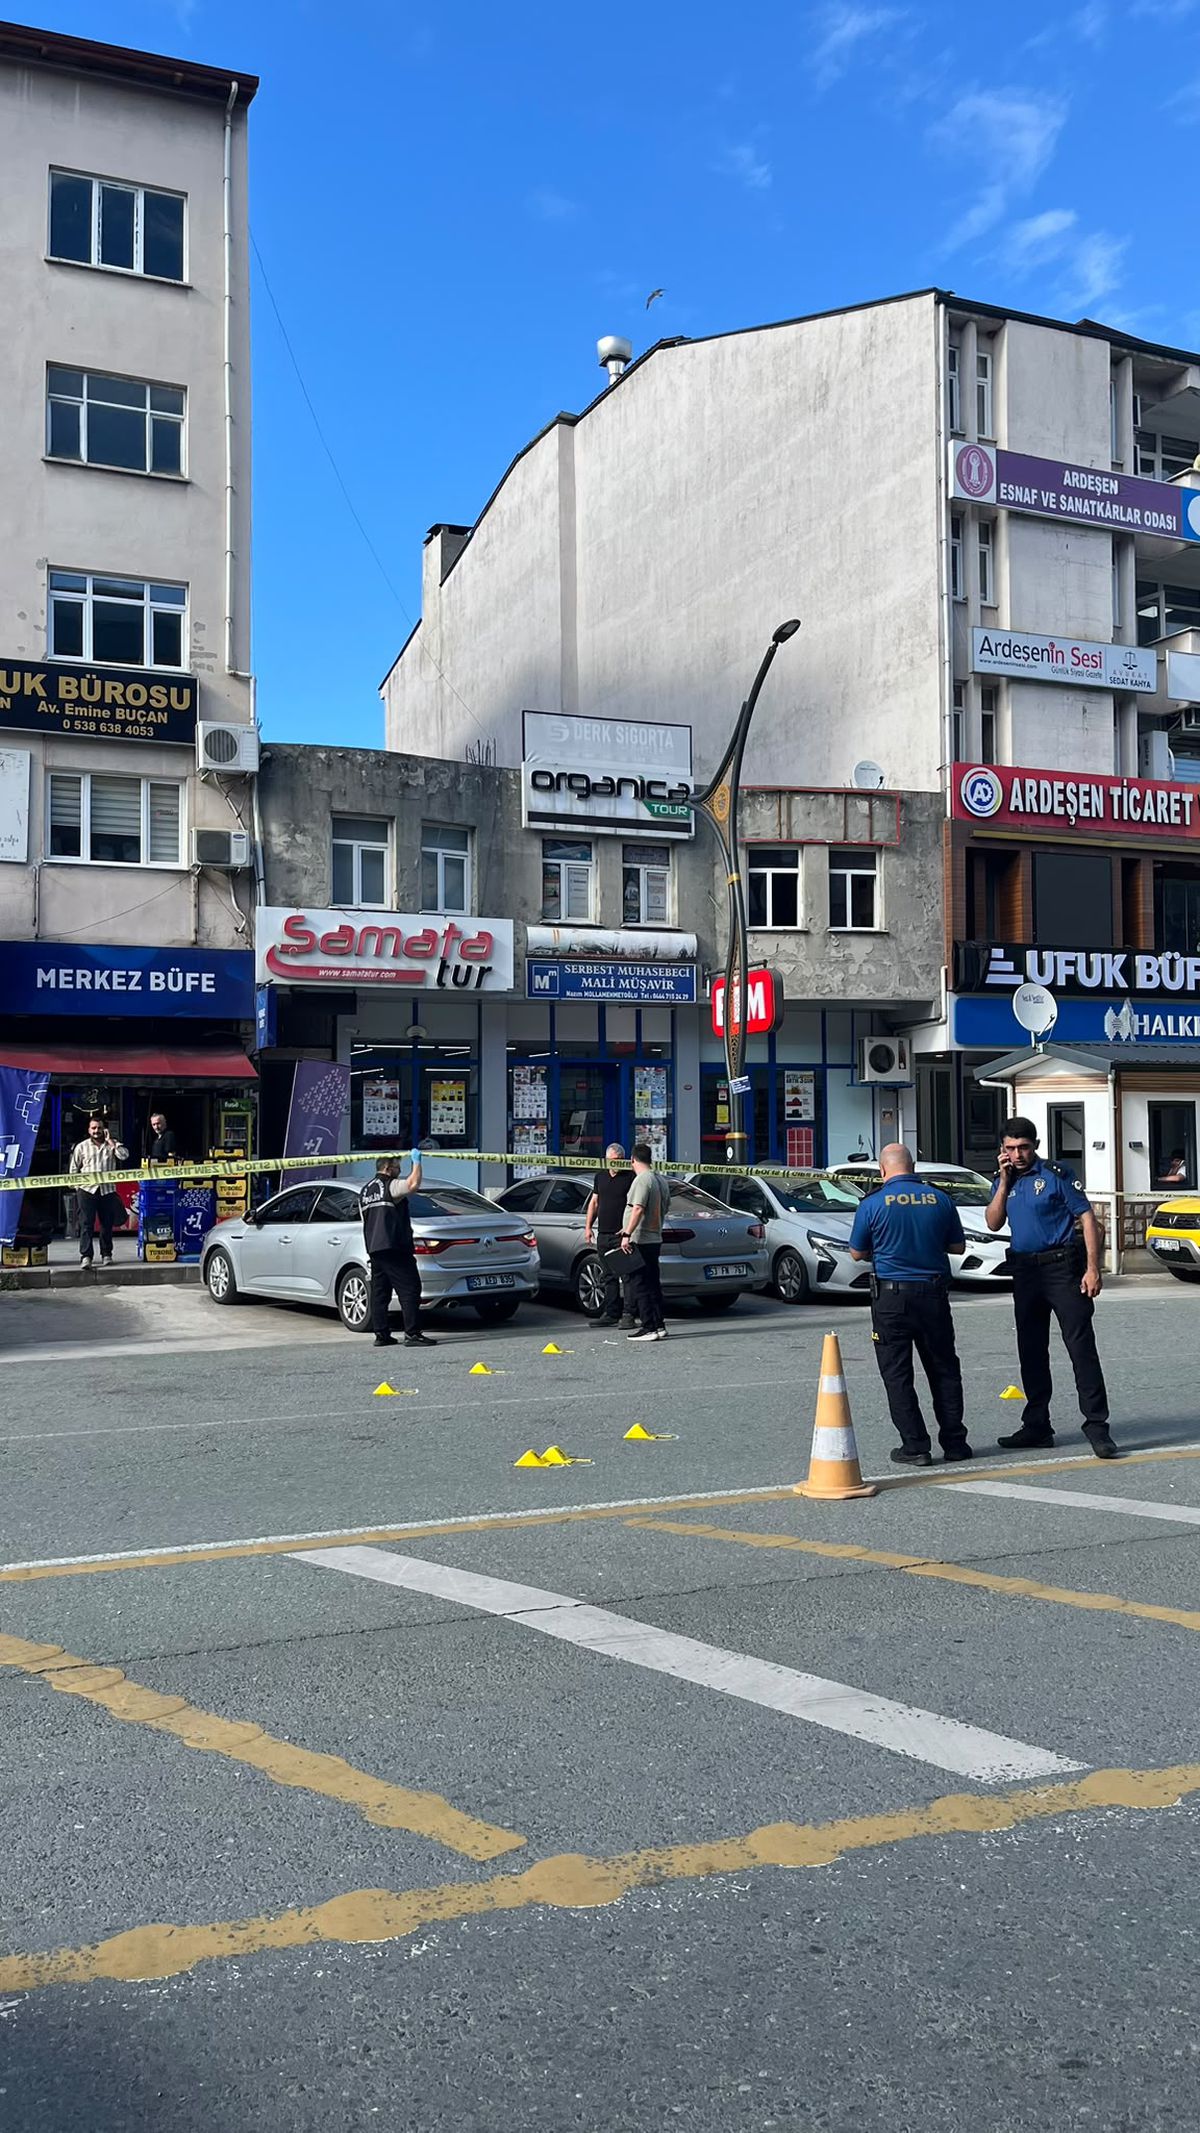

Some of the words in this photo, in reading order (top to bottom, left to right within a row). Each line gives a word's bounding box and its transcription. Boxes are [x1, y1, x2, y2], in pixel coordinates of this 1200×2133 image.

[1063, 470, 1118, 496] ARDEŞEN
[1000, 483, 1038, 504] ESNAF
[1041, 490, 1057, 509] VE
[1143, 511, 1177, 531] ODASI
[979, 636, 1065, 664] Ardeşenin
[1071, 646, 1103, 669] Sesi
[58, 674, 191, 711] BÜROSU
[1109, 676, 1129, 685] SEDAT
[1130, 679, 1151, 688] KAHYA
[37, 700, 60, 714] Av.
[64, 703, 111, 719] Emine
[115, 707, 168, 724] BUÇAN
[62, 720, 70, 729] 0
[73, 720, 97, 732] 538
[100, 722, 122, 734] 638
[125, 724, 154, 737] 4053
[573, 721, 612, 743] DERK
[651, 803, 689, 816] TOUR
[1009, 777, 1104, 826] ARDEŞEN
[1109, 778, 1193, 826] TİCARET
[278, 914, 494, 960] Samata
[36, 968, 142, 991] MERKEZ
[149, 967, 216, 993] BÜFE
[435, 956, 493, 988] tur
[564, 963, 615, 975] SERBEST
[618, 965, 690, 978] MUHASEBECİ
[1025, 949, 1129, 987] UFUK
[580, 975, 615, 989] MALİ
[618, 976, 675, 992] MÜŞAVİR
